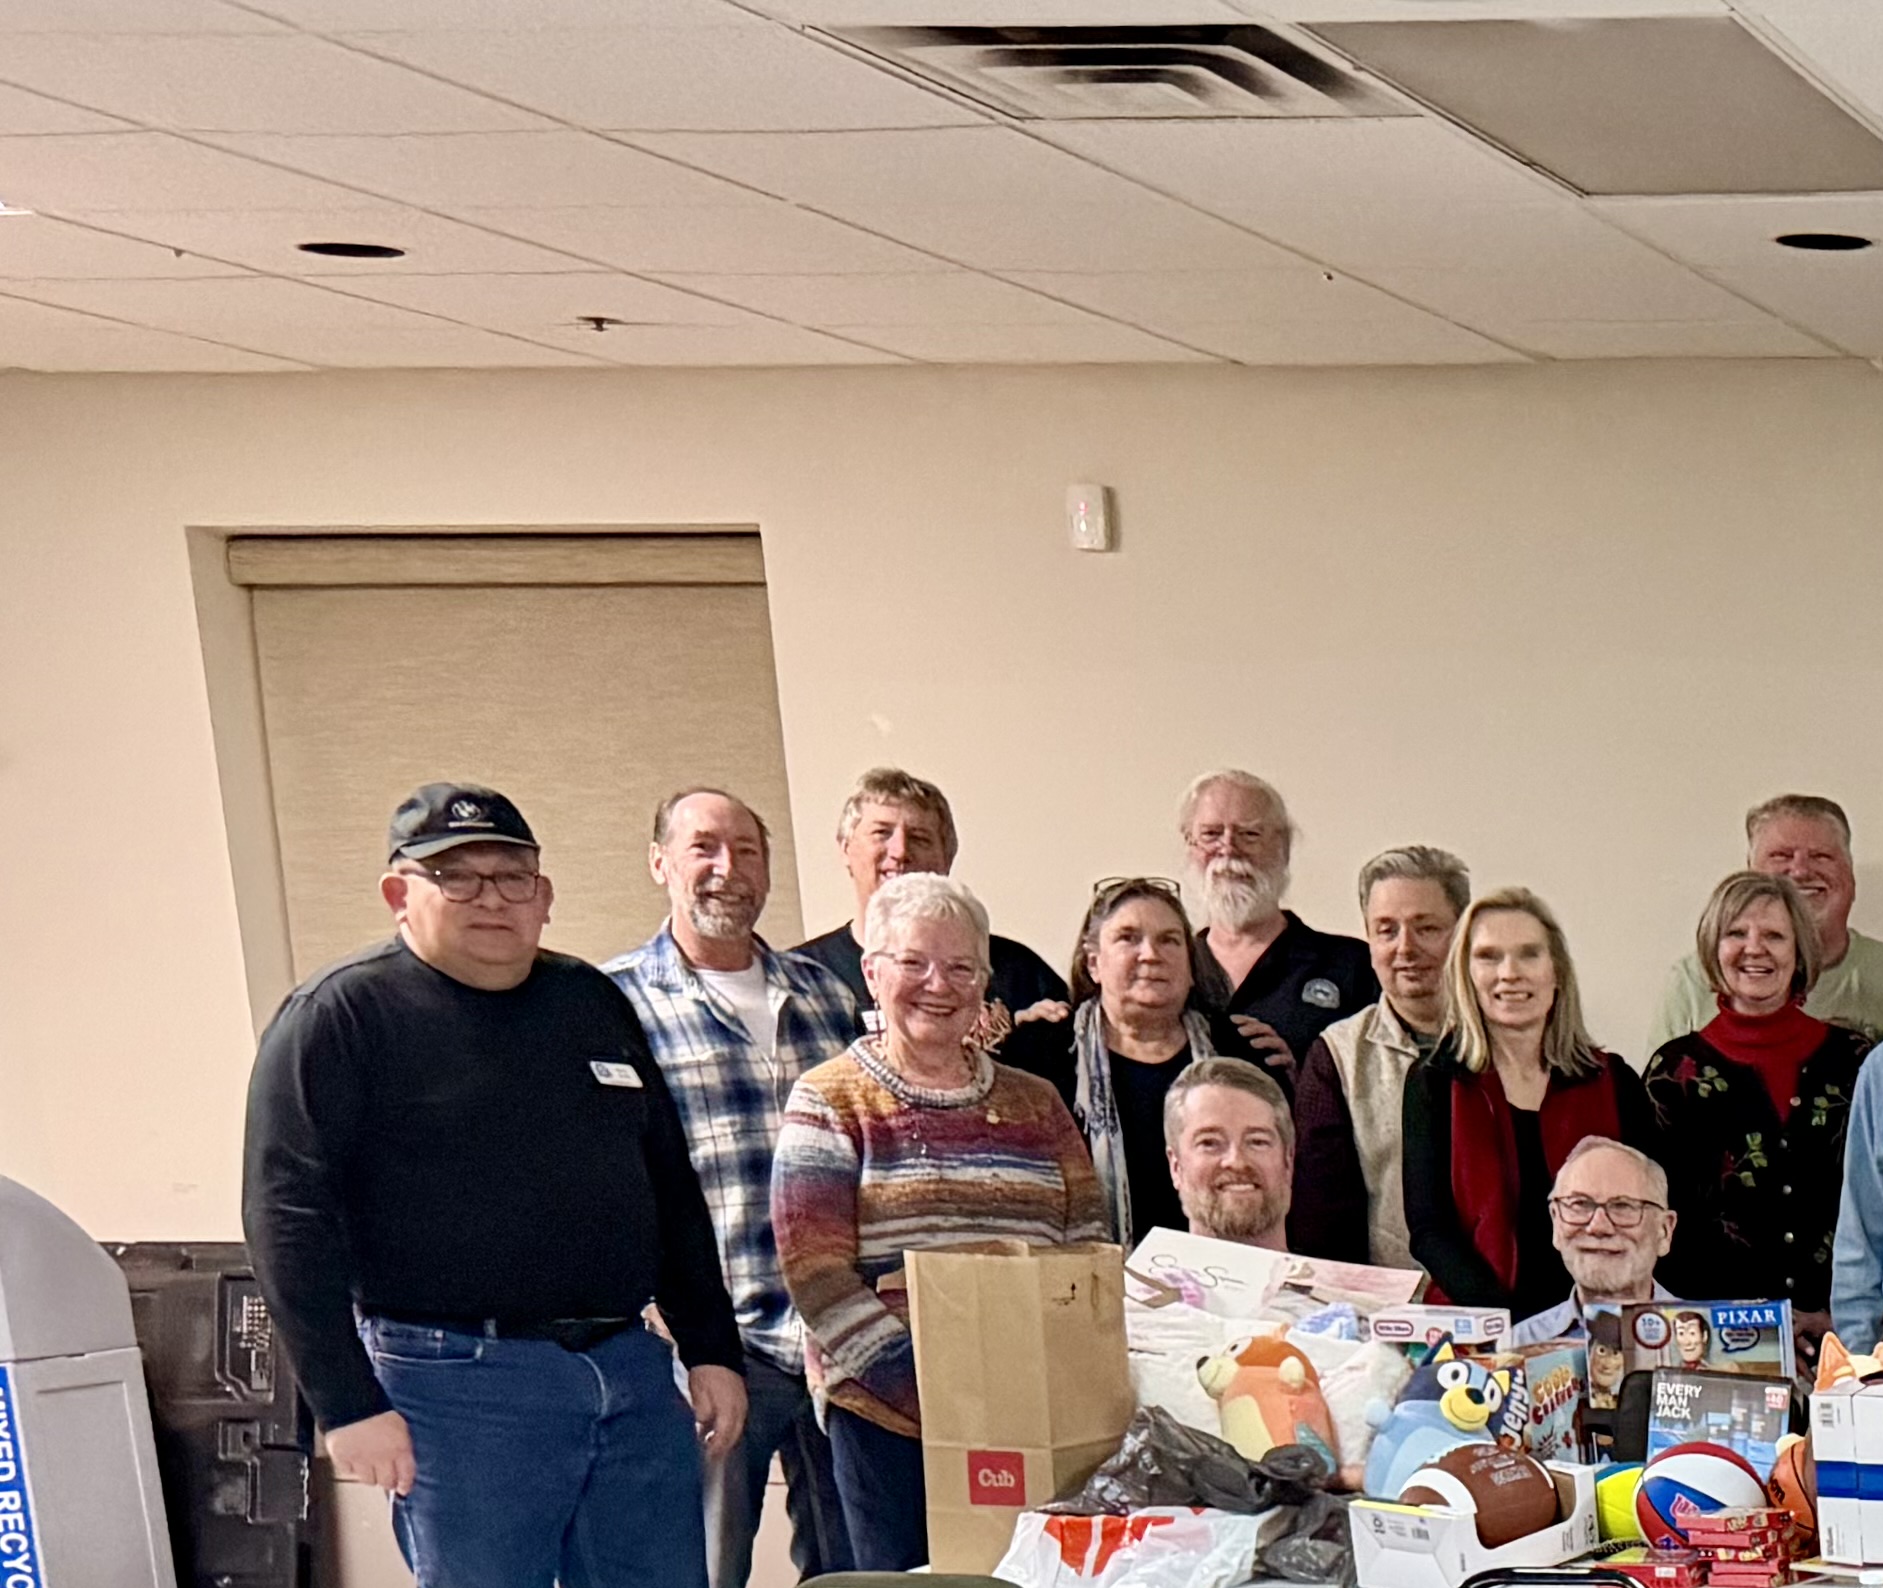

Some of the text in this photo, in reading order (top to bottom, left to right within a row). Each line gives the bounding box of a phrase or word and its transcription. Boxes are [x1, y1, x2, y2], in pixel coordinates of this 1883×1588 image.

[1717, 1309, 1777, 1325] PIXAR
[1656, 1382, 1703, 1399] EVERY
[1656, 1393, 1688, 1408] MAN
[1656, 1406, 1692, 1420] JACK
[978, 1468, 1015, 1488] Cub
